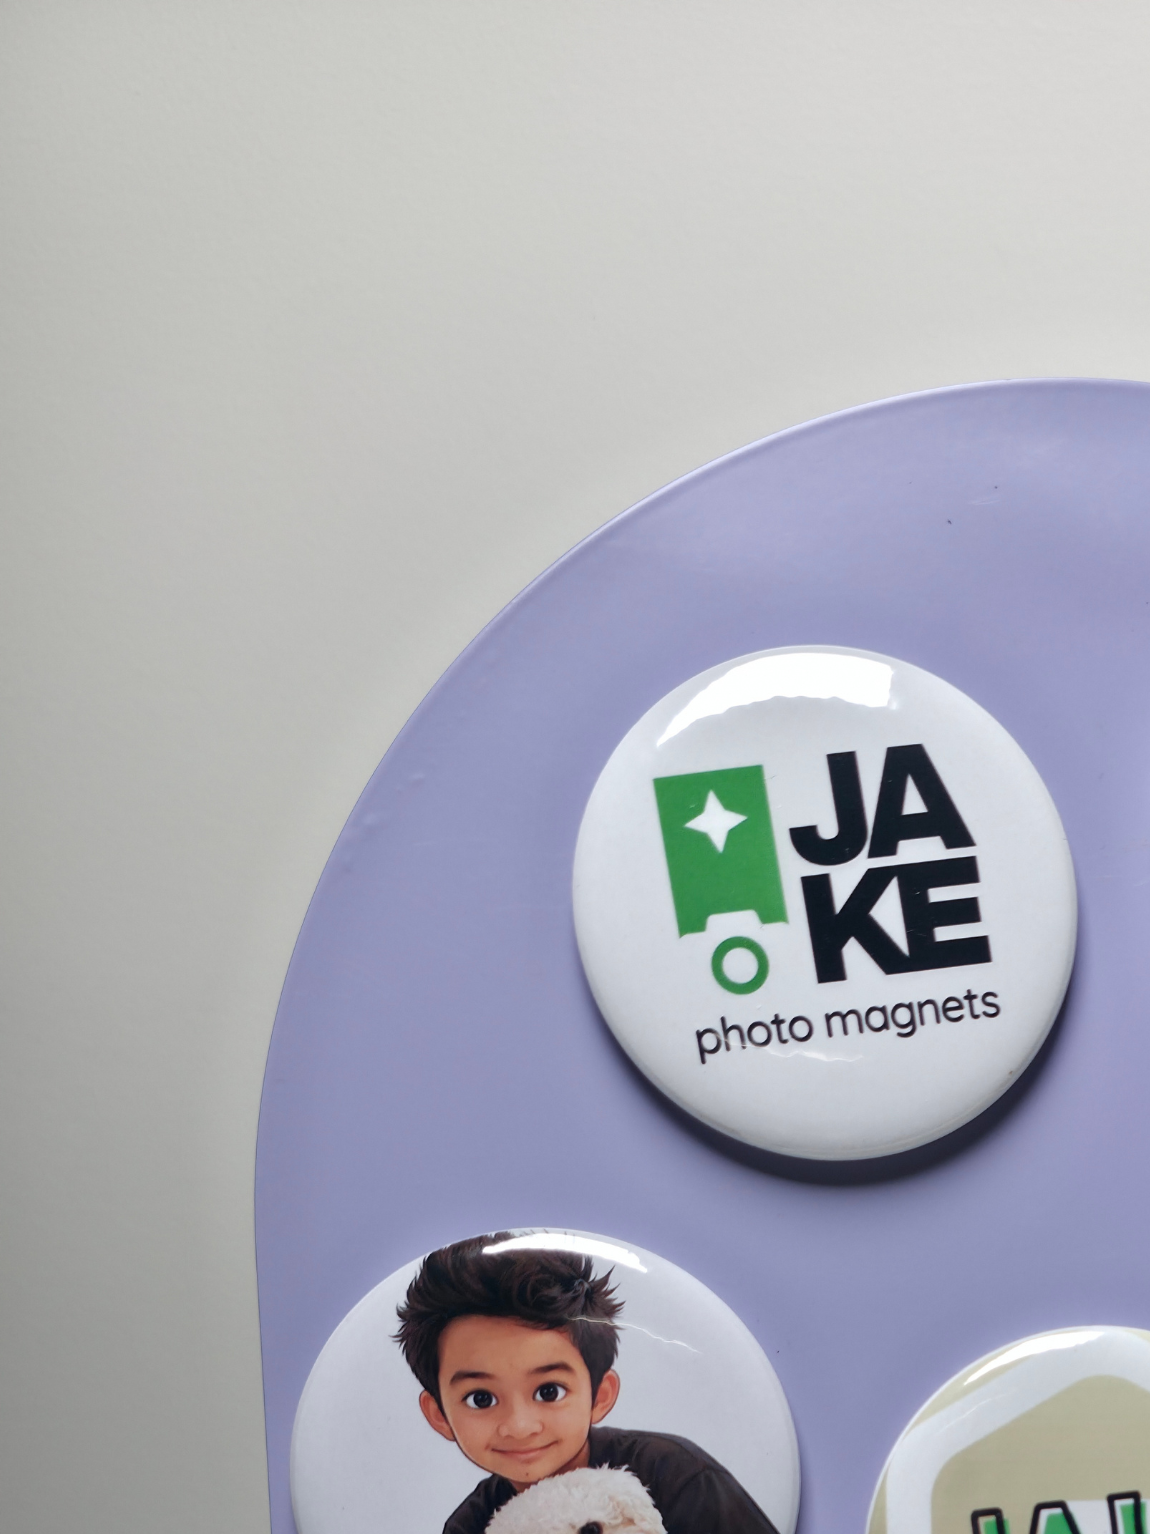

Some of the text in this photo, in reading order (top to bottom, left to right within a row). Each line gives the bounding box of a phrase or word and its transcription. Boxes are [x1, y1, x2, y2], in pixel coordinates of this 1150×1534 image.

[788, 742, 977, 867] JA
[800, 855, 993, 985] KE
[694, 988, 1002, 1065] photo magnets
